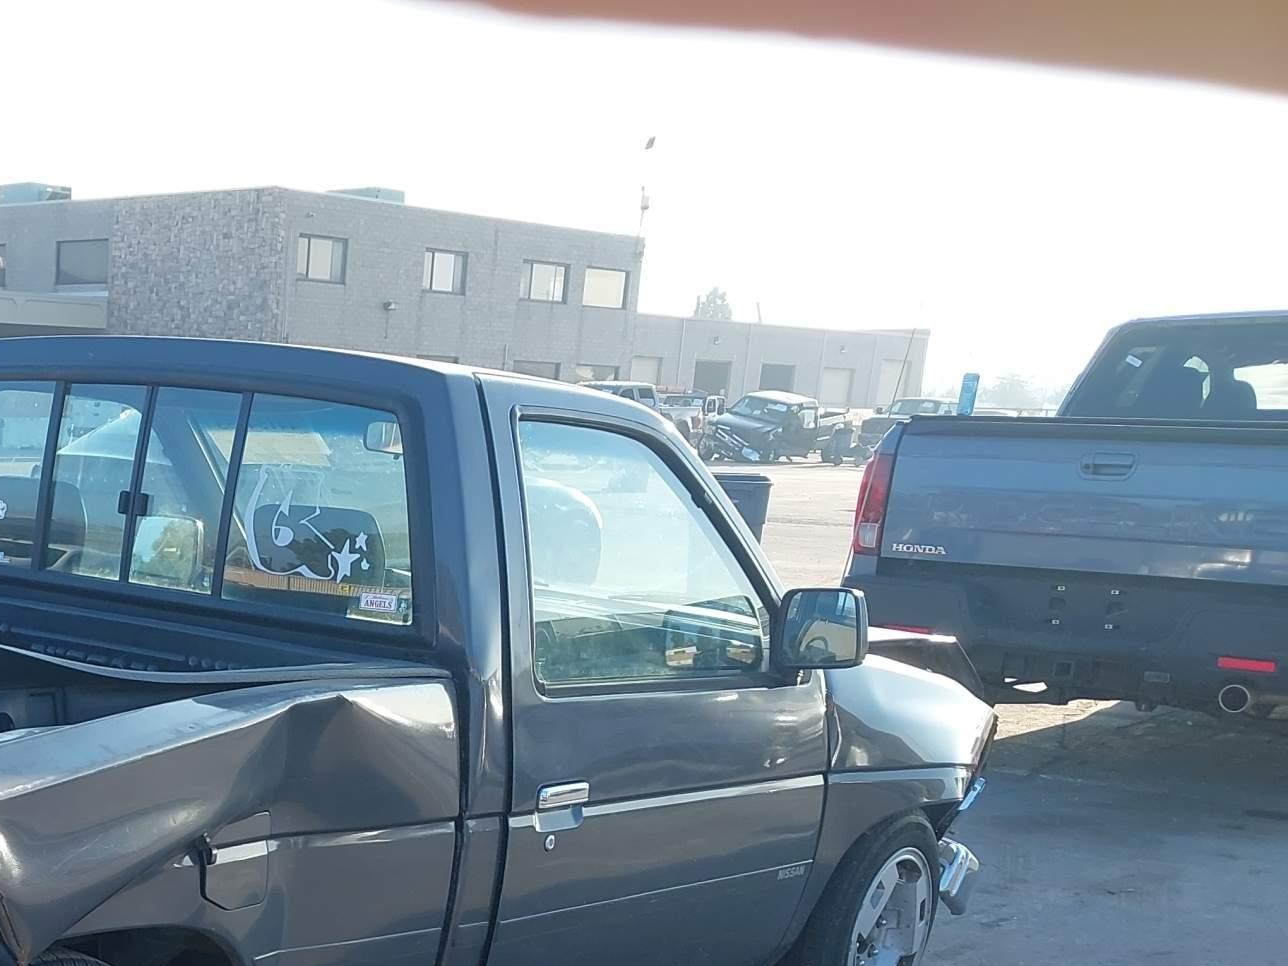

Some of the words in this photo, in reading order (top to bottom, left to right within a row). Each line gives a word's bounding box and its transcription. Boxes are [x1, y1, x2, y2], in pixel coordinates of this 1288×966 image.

[892, 543, 947, 555] HONDA
[364, 599, 393, 609] ANGELS
[777, 864, 806, 881] NISSAN
